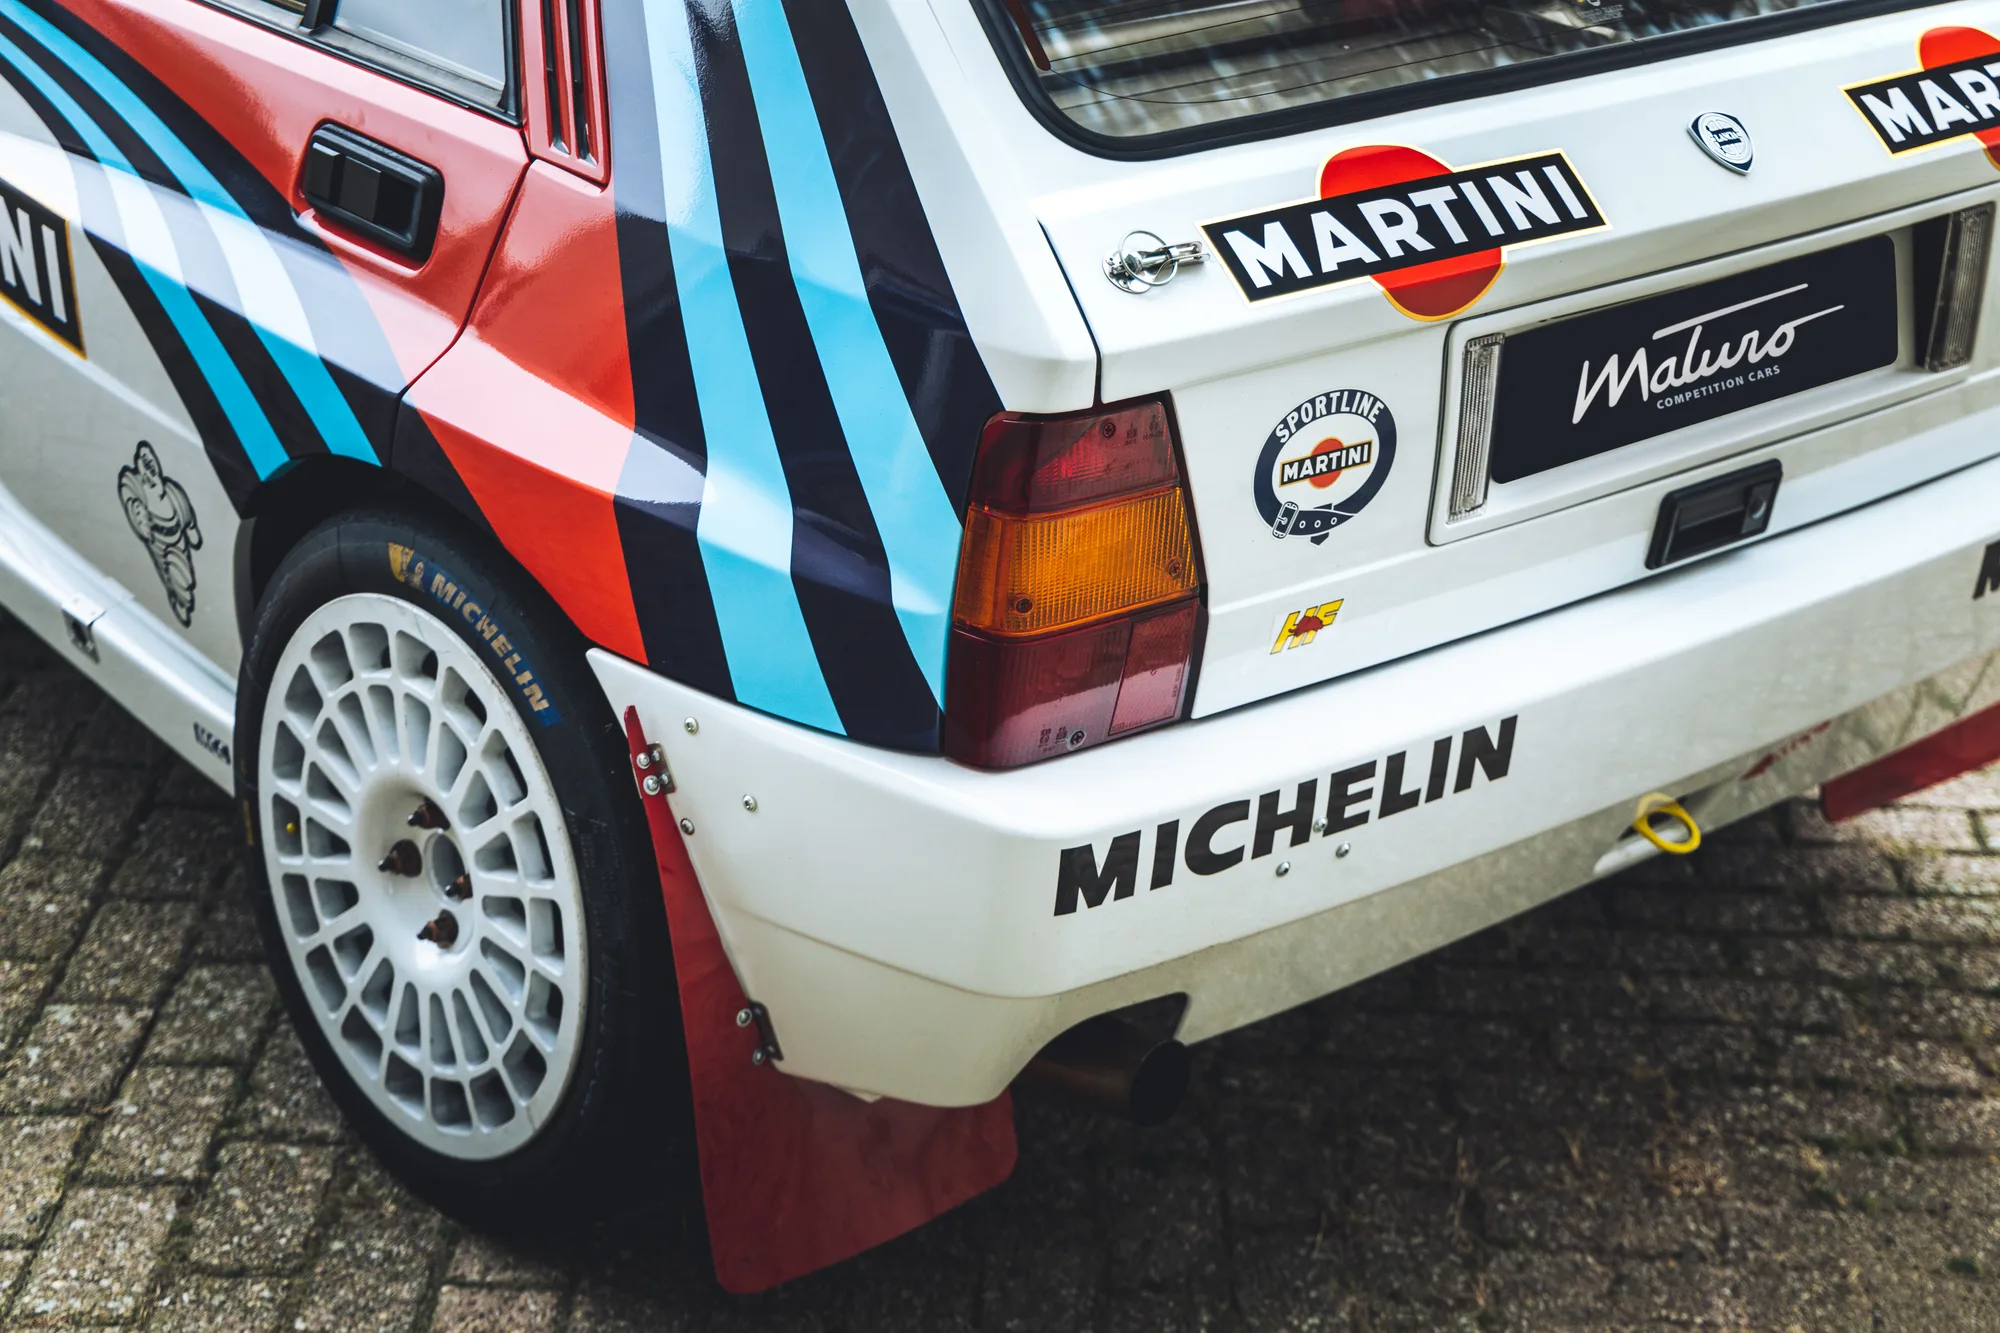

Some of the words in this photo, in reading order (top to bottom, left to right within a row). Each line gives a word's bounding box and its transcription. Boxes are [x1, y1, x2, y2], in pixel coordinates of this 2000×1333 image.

[1222, 164, 1589, 289] MARTINI
[1572, 283, 1845, 425] Maturo
[1656, 376, 1745, 410] COMPETITION
[1748, 365, 1781, 383] CARS
[1275, 391, 1385, 444] SPORTLINE
[1282, 443, 1370, 483] MARTINI
[431, 572, 550, 713] MICHELIN
[1269, 598, 1345, 656] HF
[1053, 714, 1519, 917] MICHELIN
